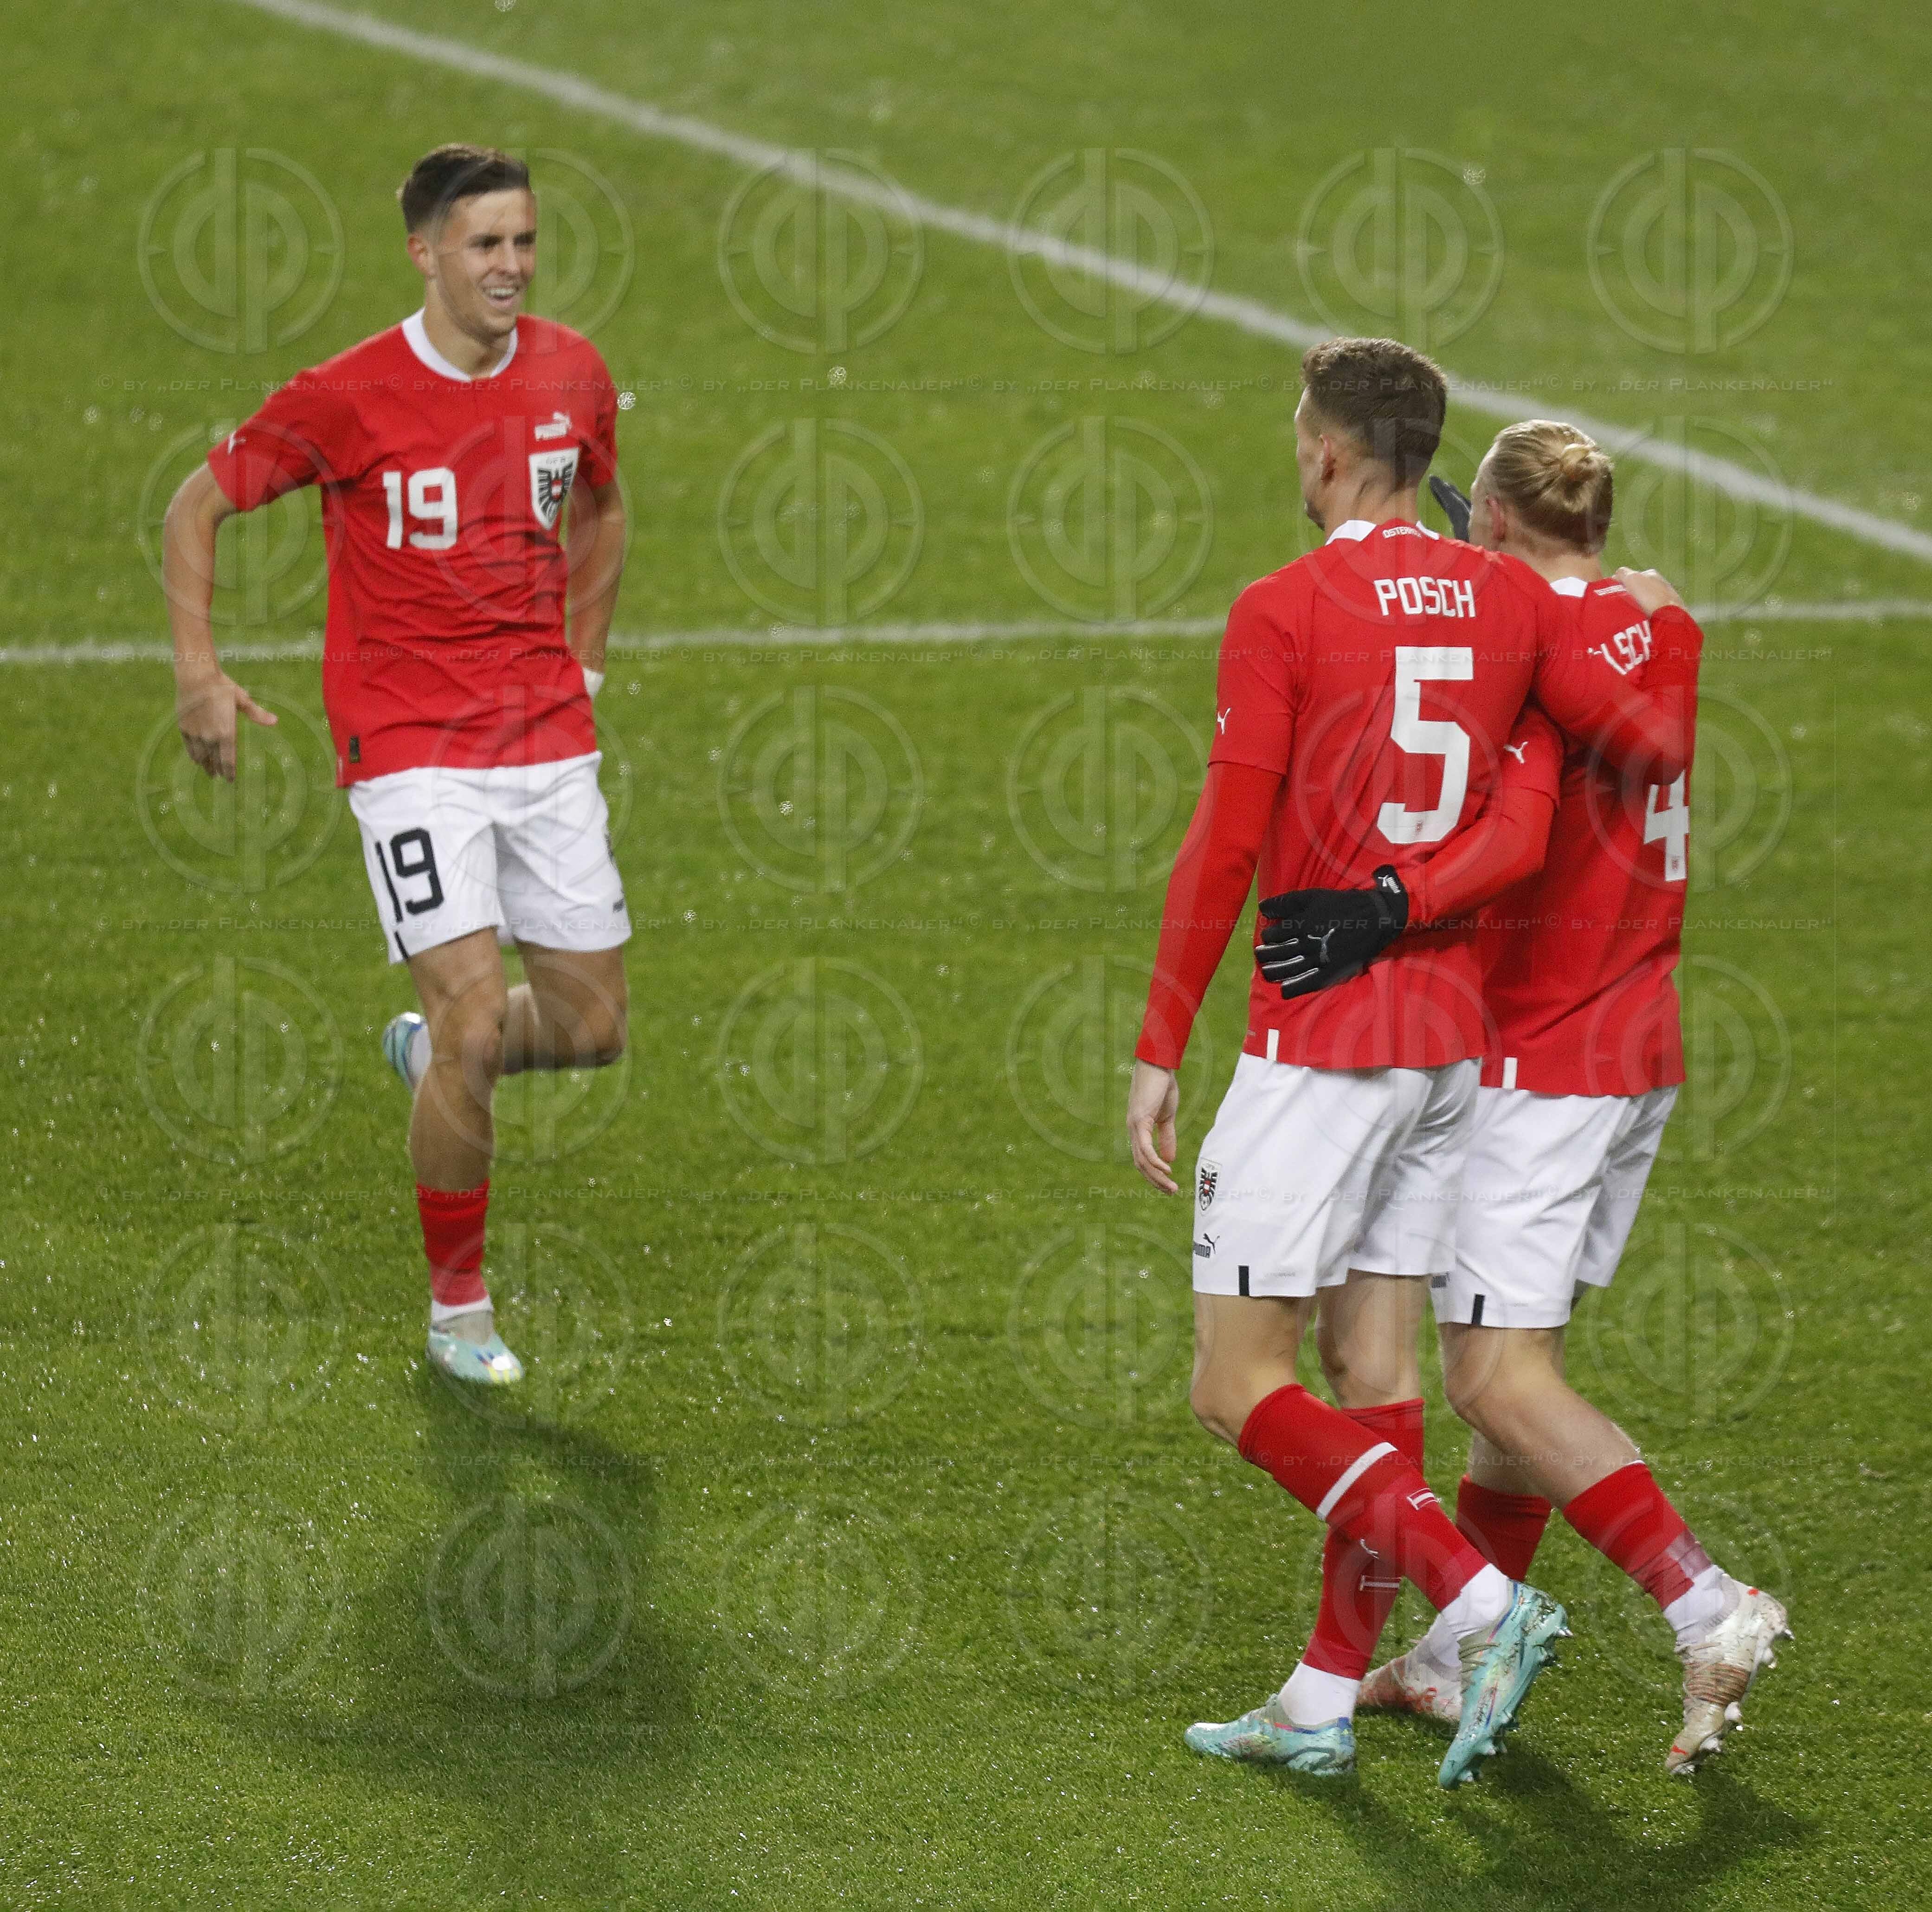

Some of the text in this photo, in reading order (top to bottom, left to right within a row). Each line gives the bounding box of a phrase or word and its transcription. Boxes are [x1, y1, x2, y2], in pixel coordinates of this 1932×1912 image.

[383, 466, 457, 550] 19
[1373, 576, 1476, 618] POSCH
[1377, 646, 1474, 844] 5
[1643, 770, 1690, 882] 4
[375, 827, 444, 923] 19
